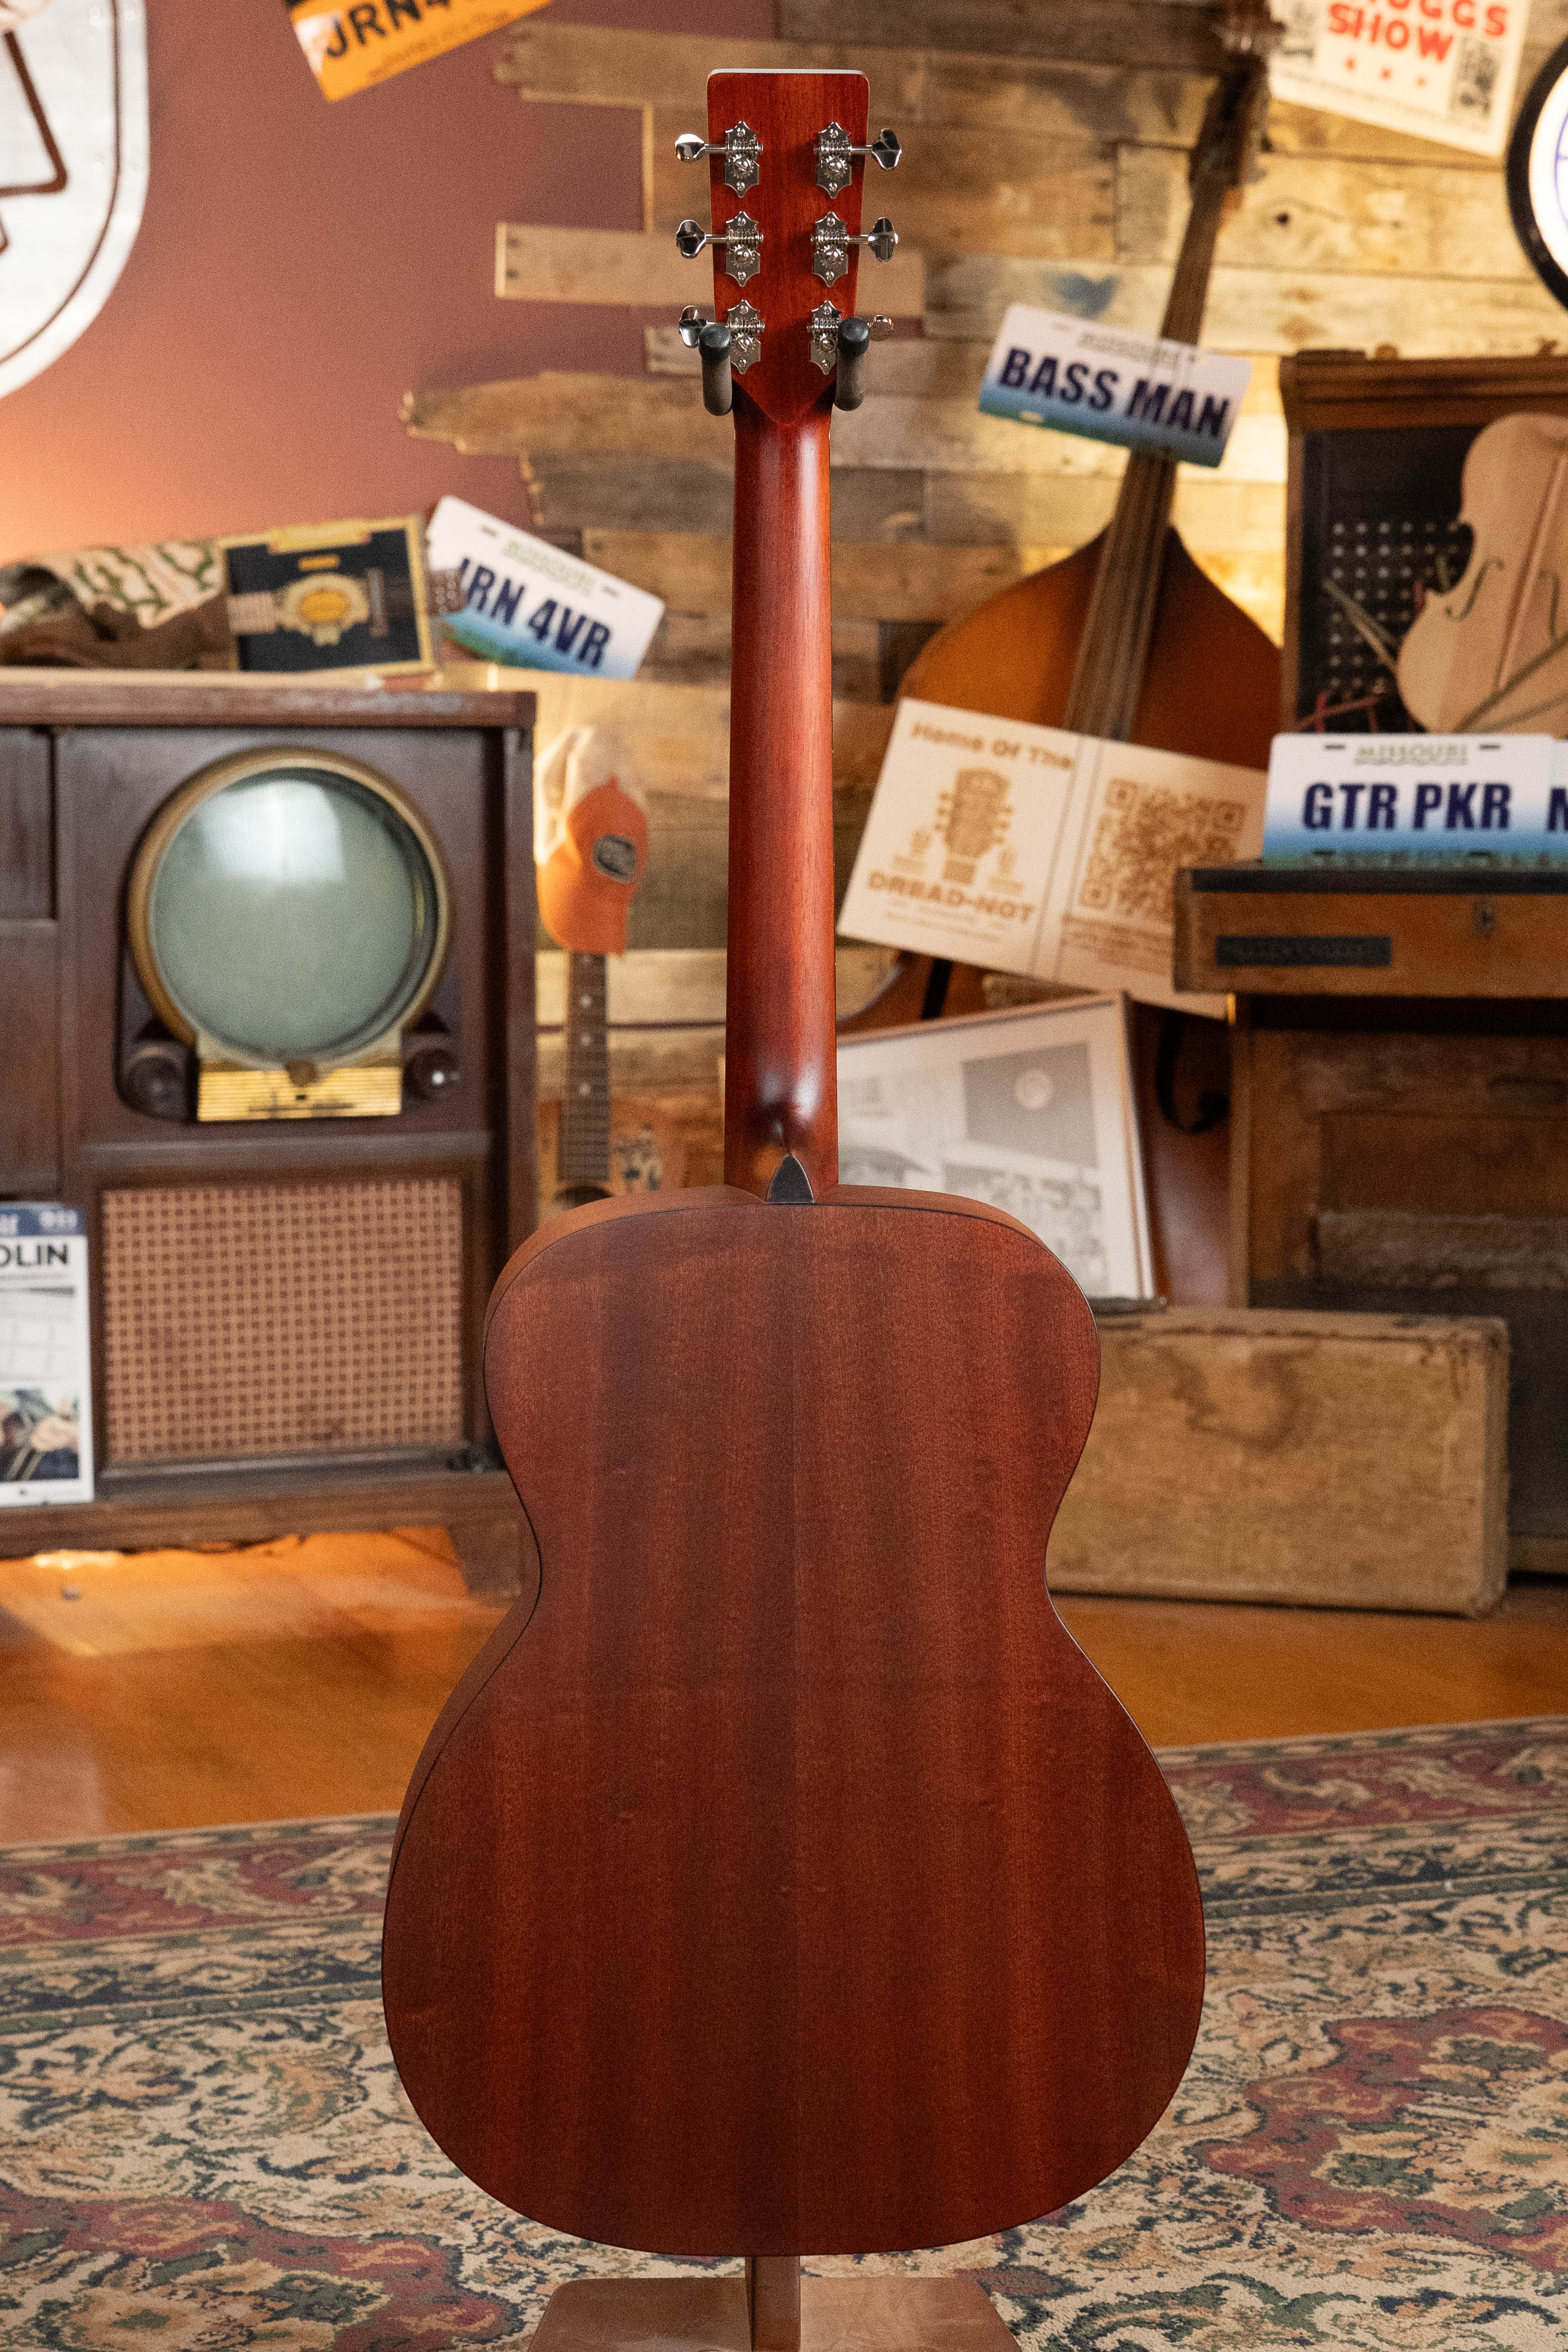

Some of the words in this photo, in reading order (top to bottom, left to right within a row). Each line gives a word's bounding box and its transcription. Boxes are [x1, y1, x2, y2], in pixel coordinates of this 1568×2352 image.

[326, 0, 451, 57] JRN
[1327, 2, 1454, 62] SHOW
[999, 346, 1119, 411] BASS
[1127, 378, 1230, 436] MAN
[528, 599, 612, 670] 4VR
[1302, 783, 1397, 830] GTR
[1414, 783, 1511, 830] PKR
